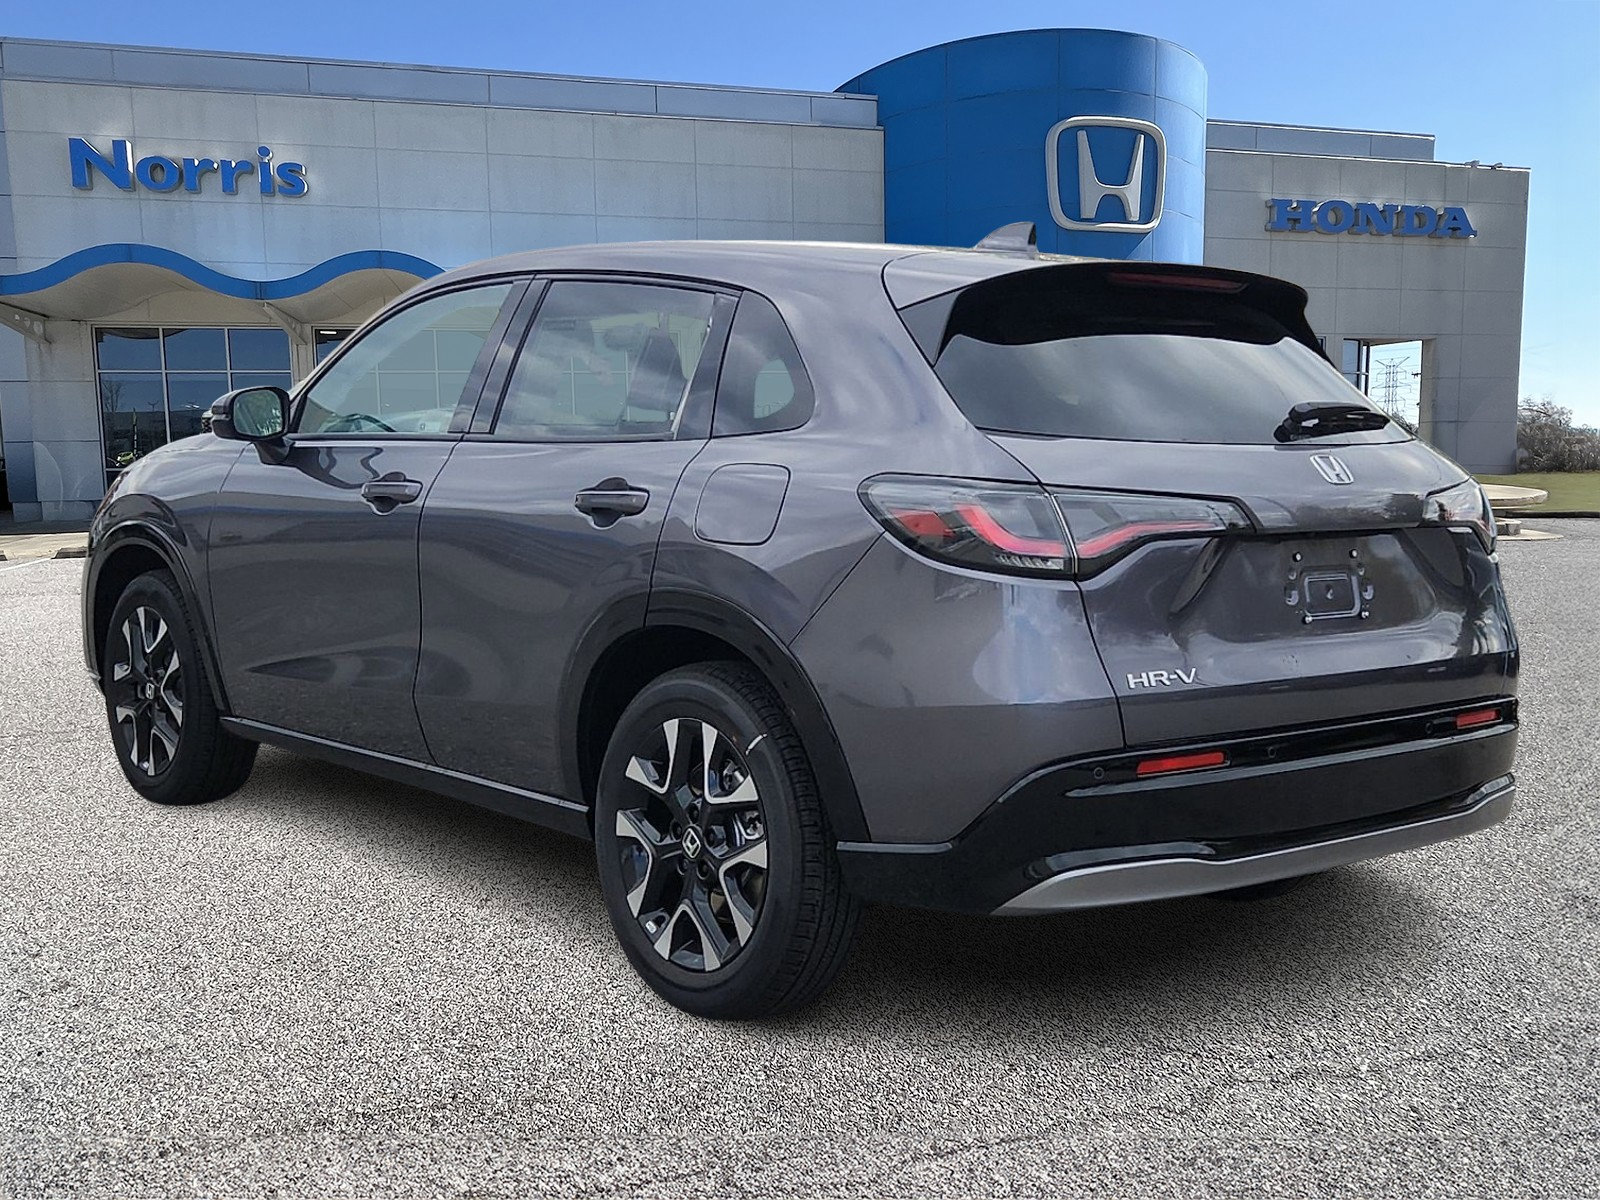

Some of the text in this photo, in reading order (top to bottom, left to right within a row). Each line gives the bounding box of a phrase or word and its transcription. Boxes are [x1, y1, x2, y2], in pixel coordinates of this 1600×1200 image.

[68, 137, 308, 197] Norris
[1266, 198, 1478, 238] HONDA
[1126, 667, 1197, 689] HR-V
